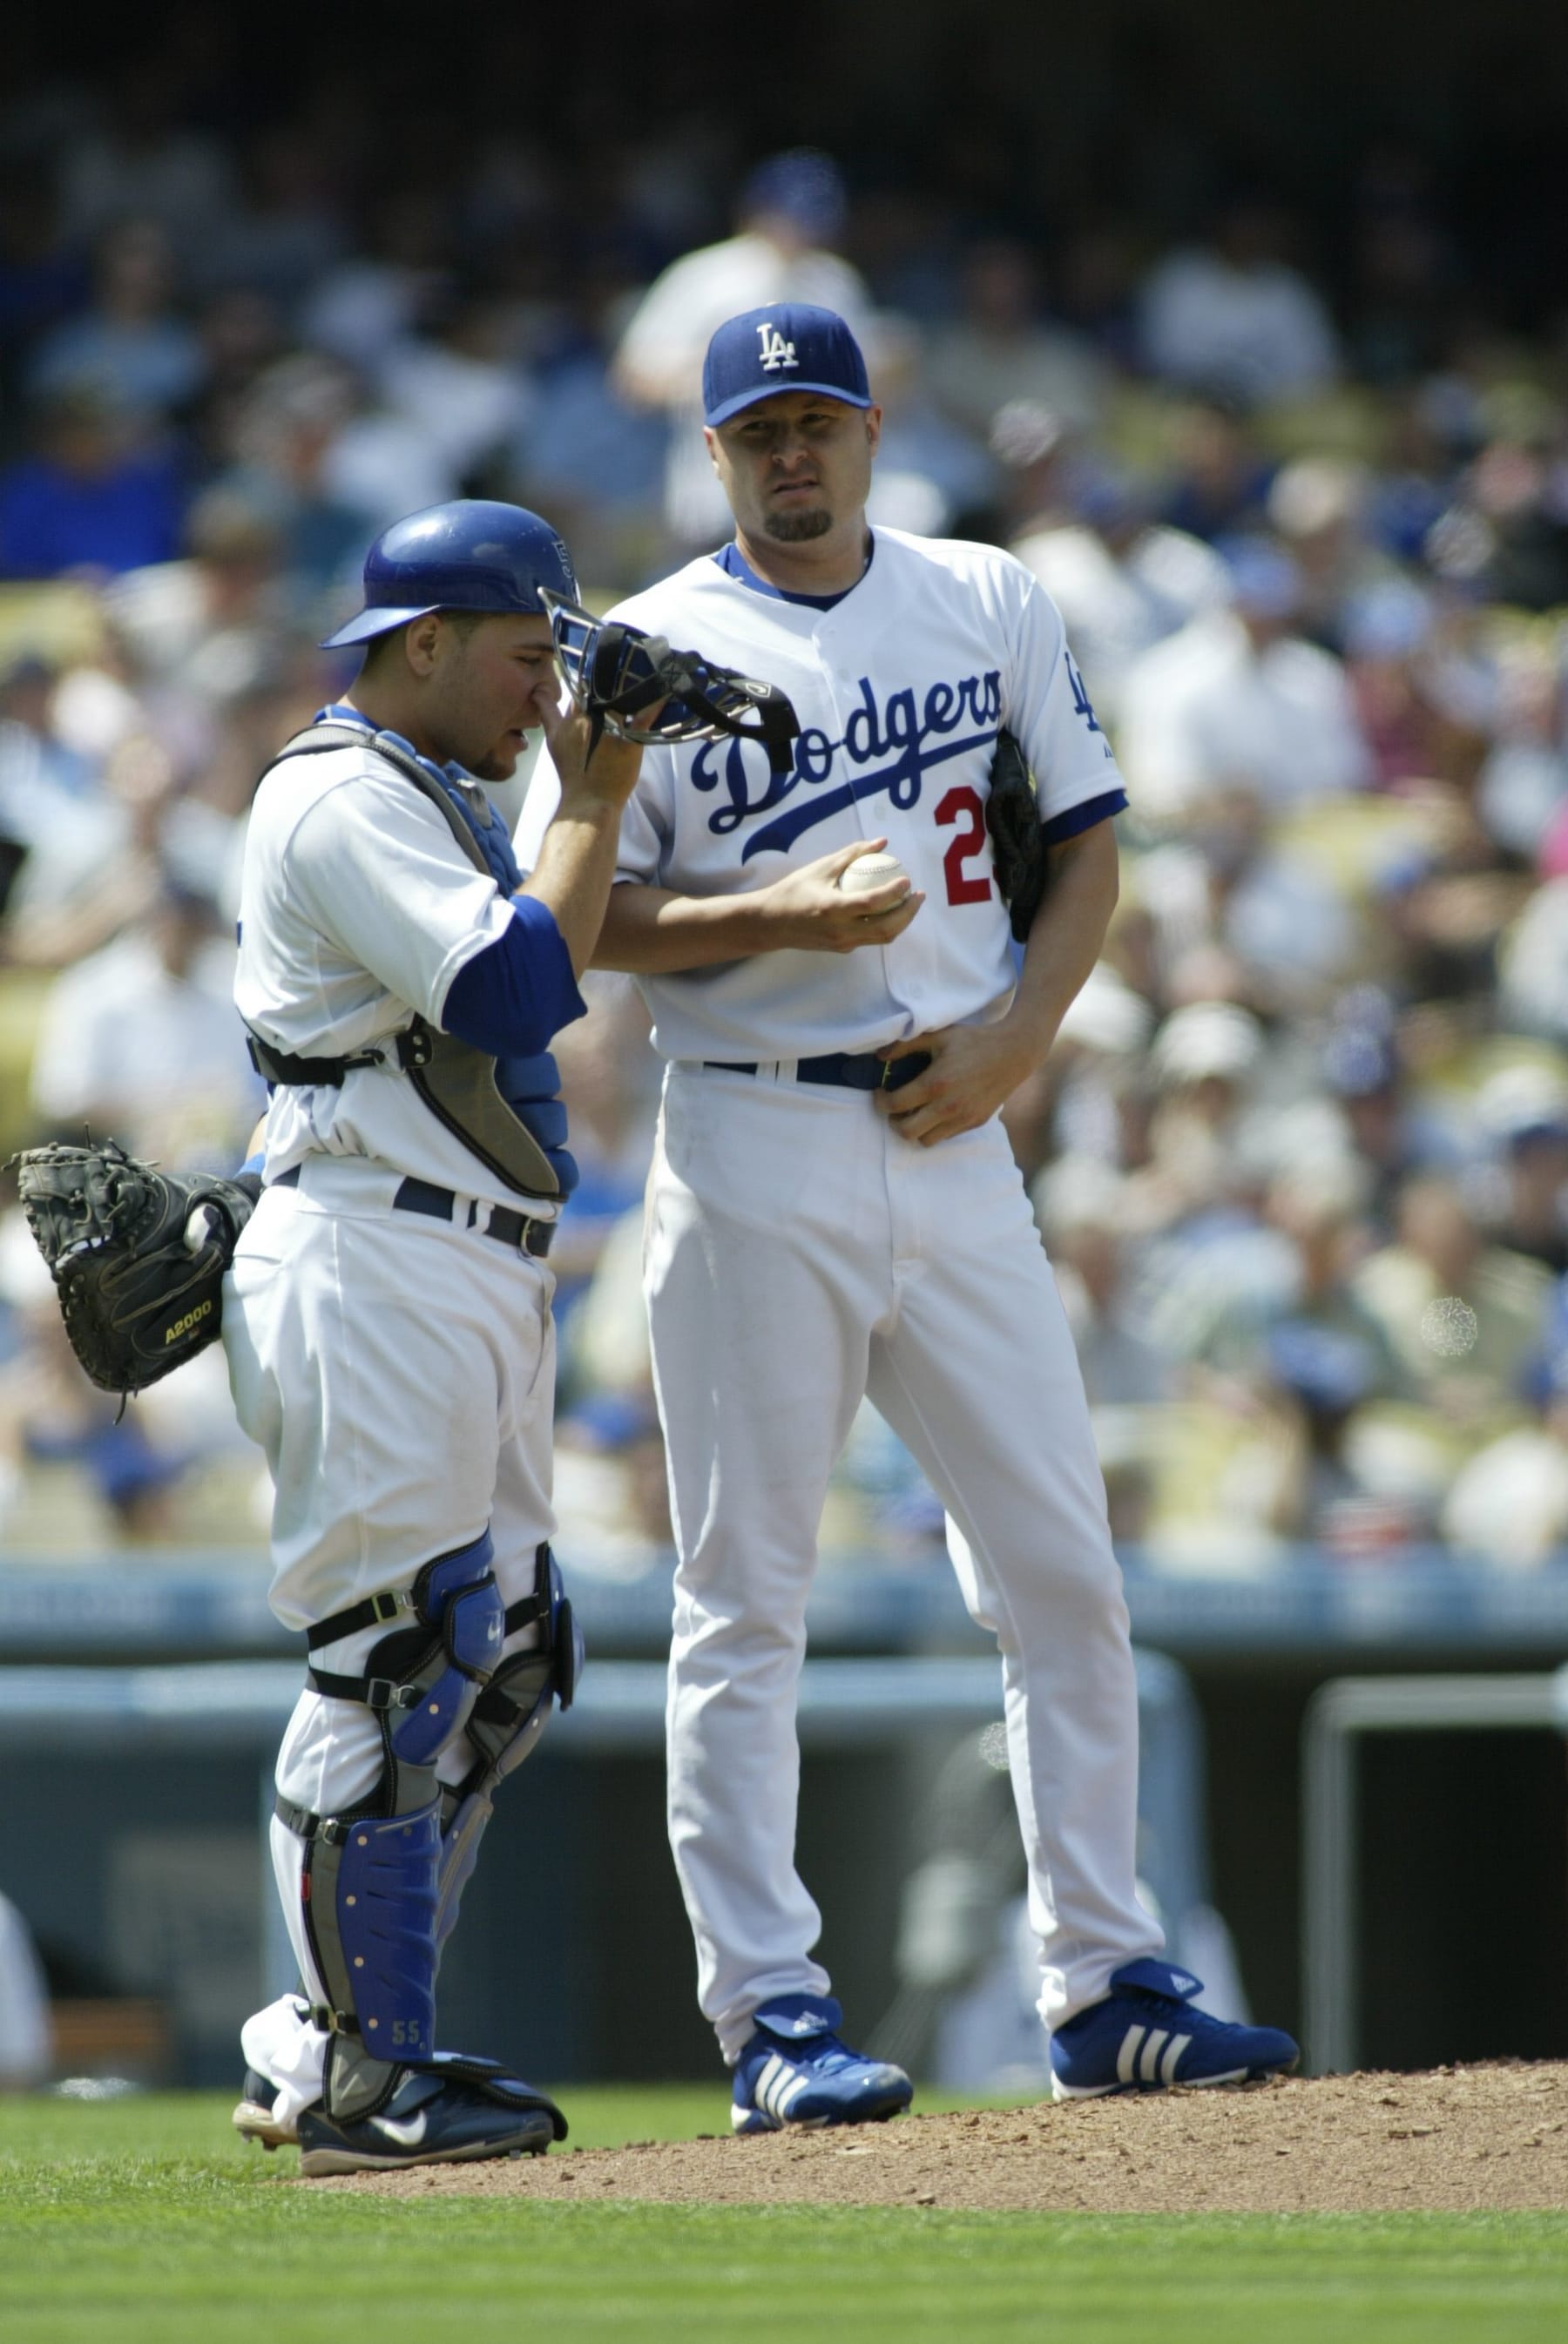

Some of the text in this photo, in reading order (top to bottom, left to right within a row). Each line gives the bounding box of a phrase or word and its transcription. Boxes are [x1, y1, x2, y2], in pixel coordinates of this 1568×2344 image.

[756, 323, 799, 371] LA
[691, 670, 1002, 834] Dodgers
[934, 786, 999, 906] 2
[165, 1299, 212, 1346] A2000
[391, 2019, 420, 2046] 55
